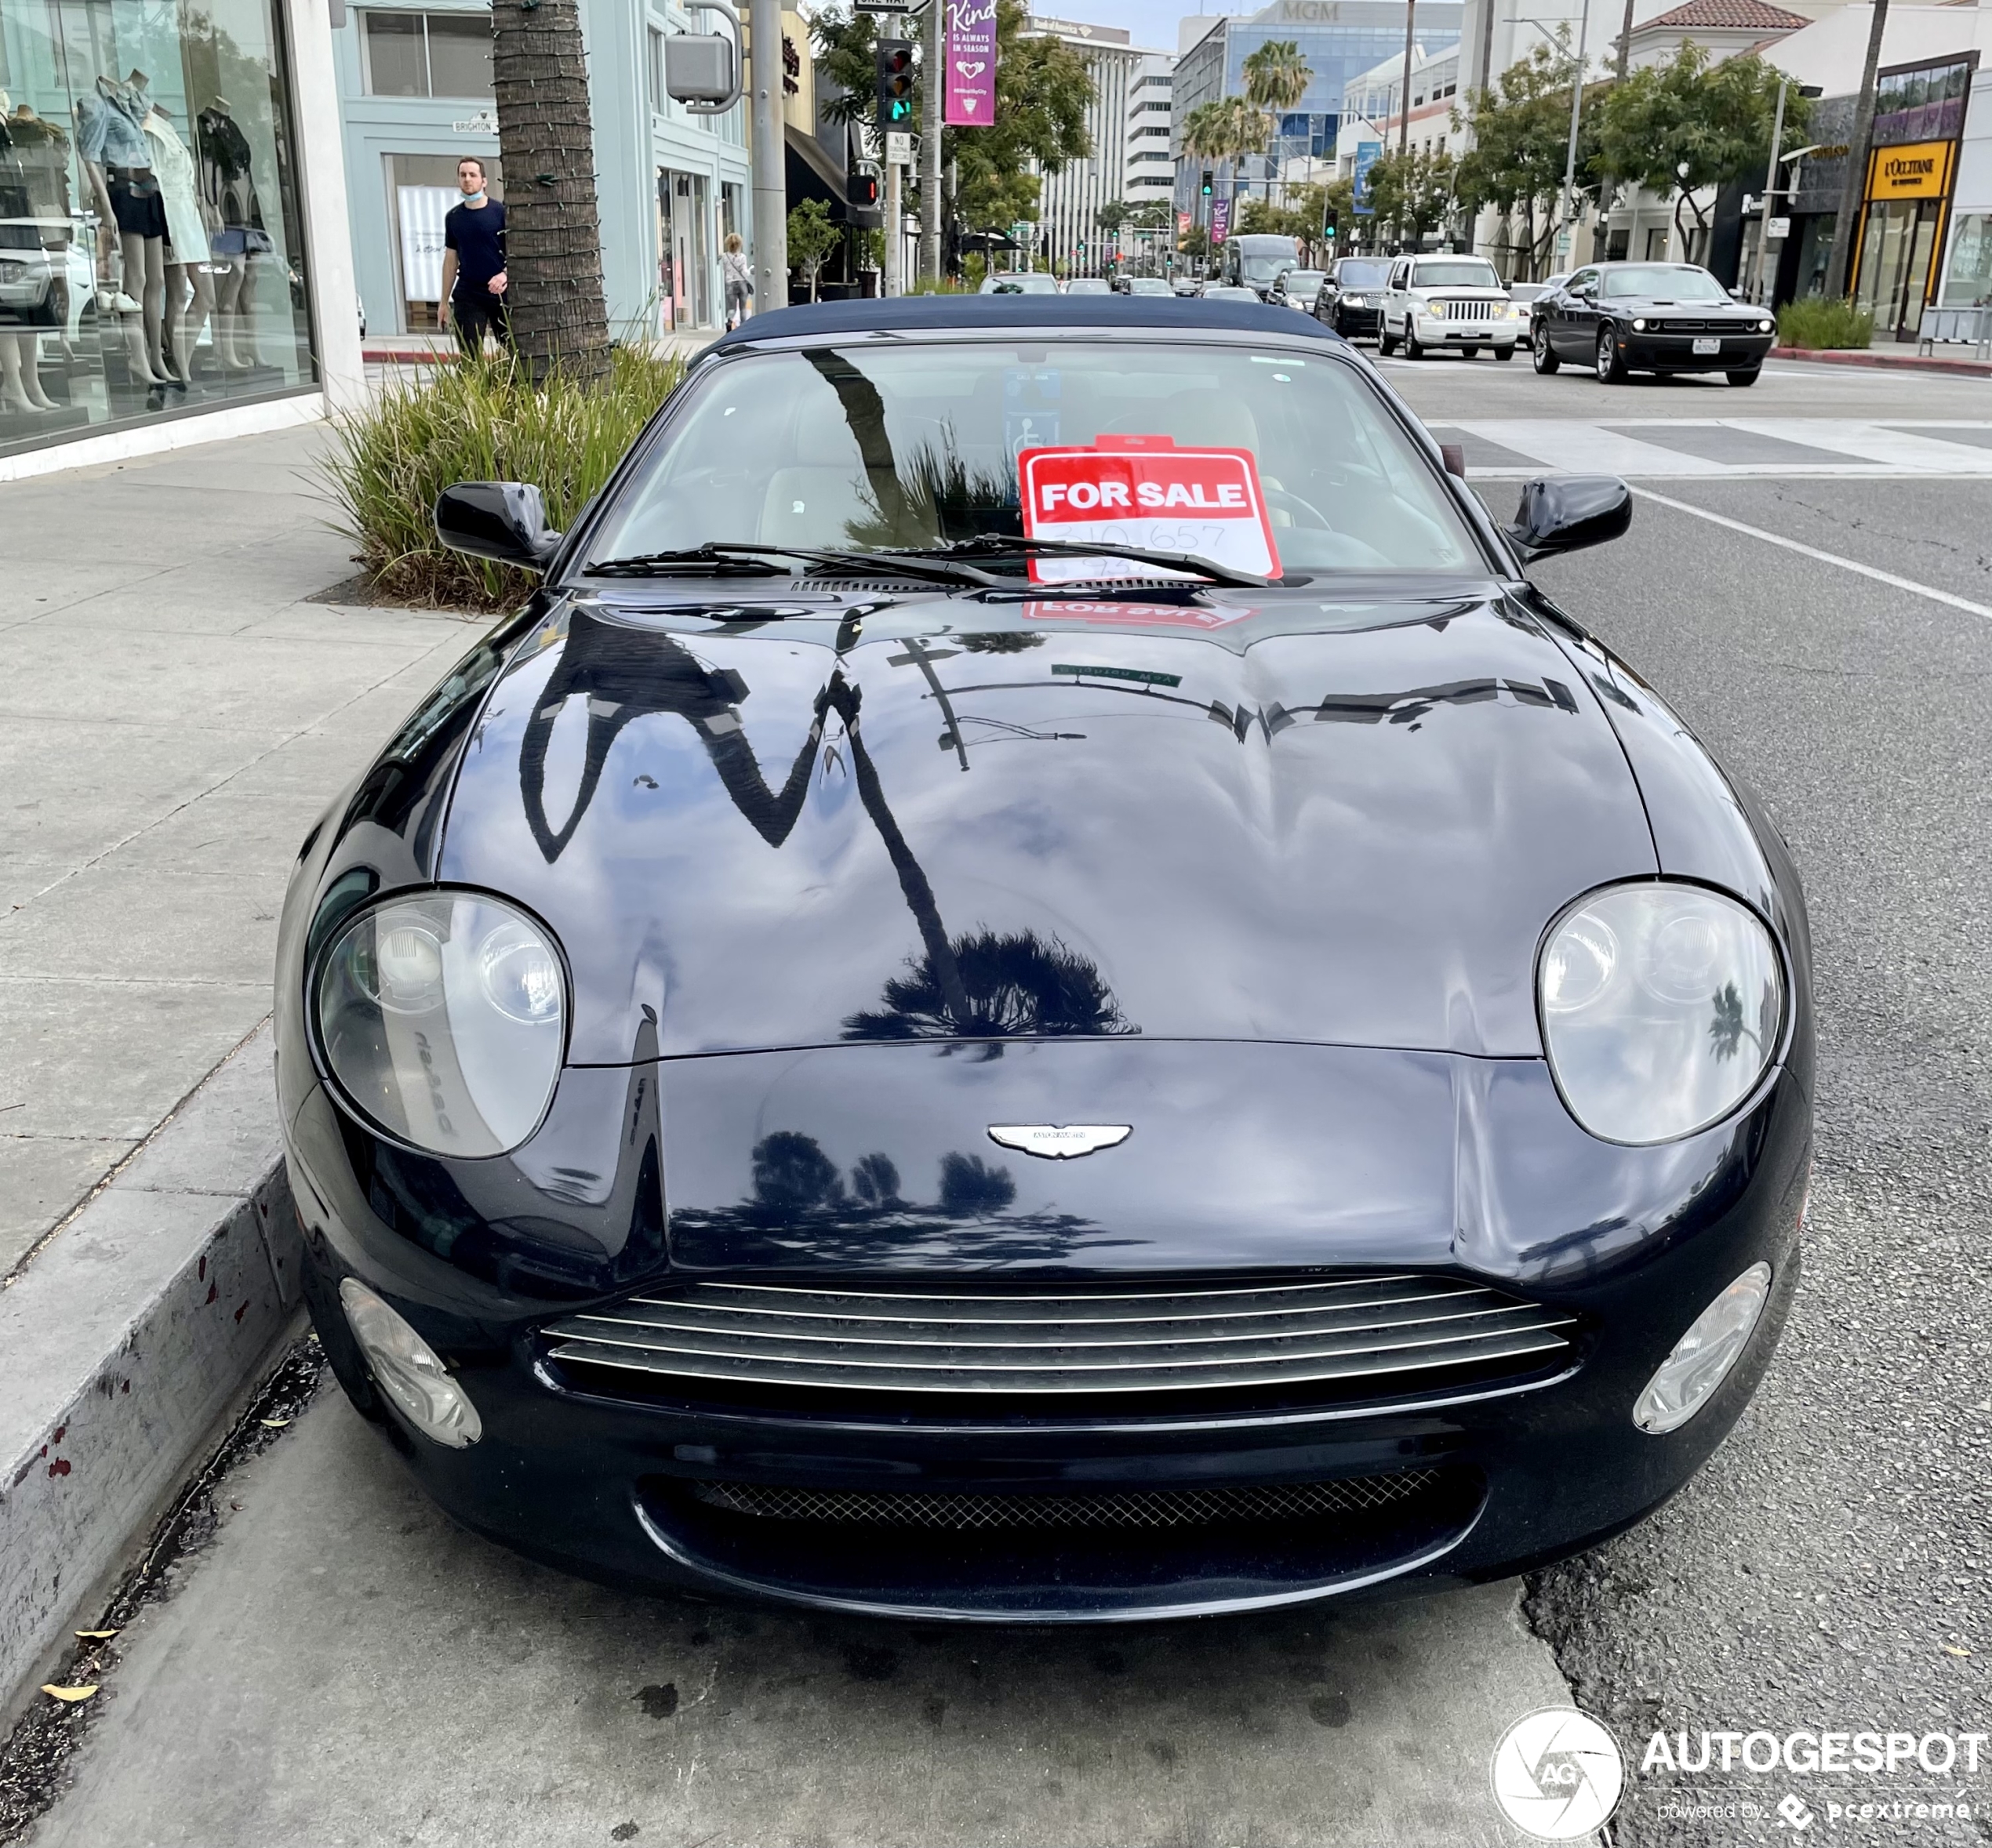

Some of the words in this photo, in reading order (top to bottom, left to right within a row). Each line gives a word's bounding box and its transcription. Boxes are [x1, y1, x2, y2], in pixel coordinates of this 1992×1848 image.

[947, 0, 997, 31] Kind
[1281, 2, 1340, 20] MGM
[961, 34, 990, 42] ALWAYS
[963, 44, 989, 53] SEASON
[455, 122, 491, 132] BRIGHTON
[895, 136, 904, 146] NO
[1041, 481, 1132, 511] FOR
[1137, 481, 1248, 508] SALE
